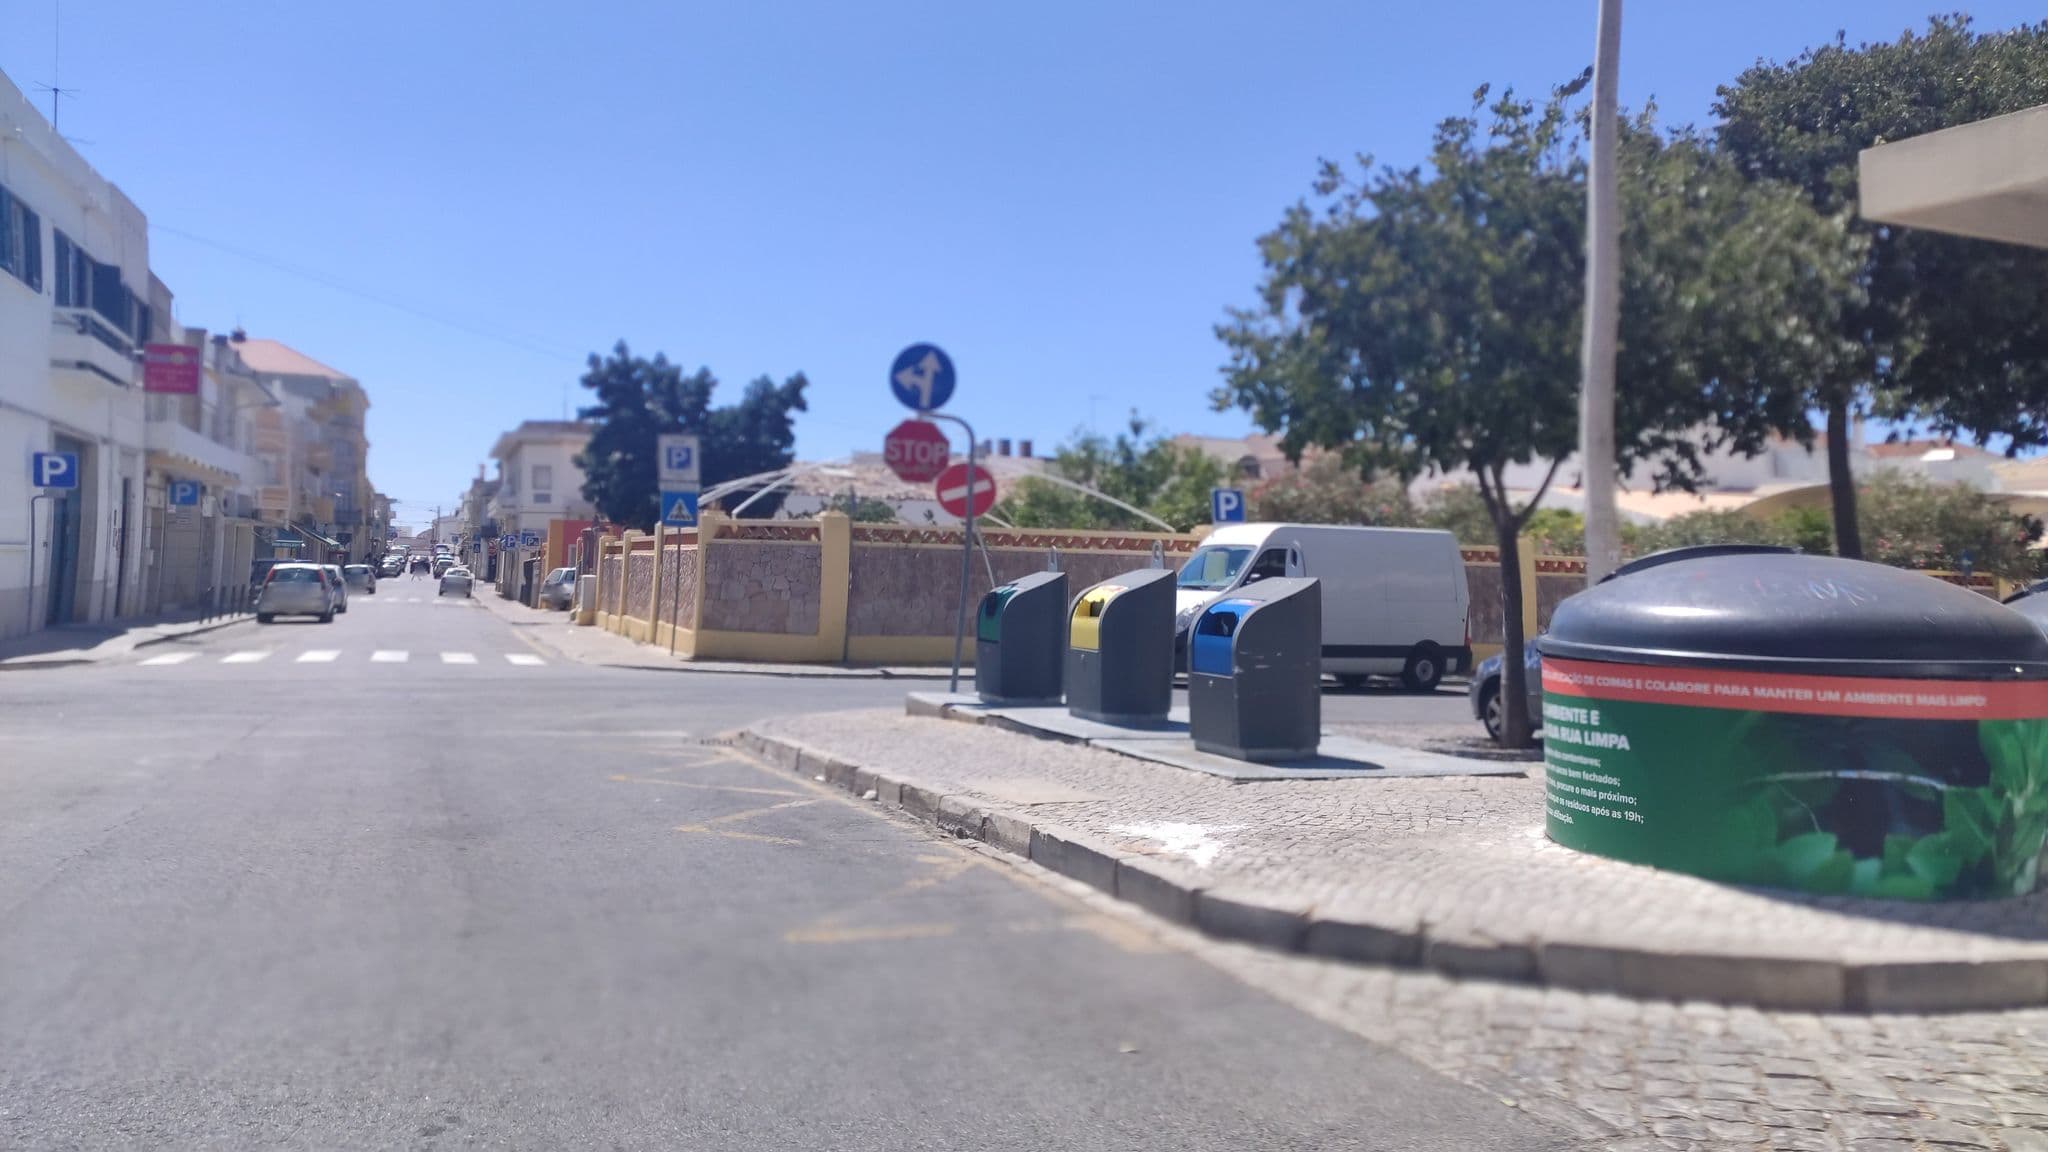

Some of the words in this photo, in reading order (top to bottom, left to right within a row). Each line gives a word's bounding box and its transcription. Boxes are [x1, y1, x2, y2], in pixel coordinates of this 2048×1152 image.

[884, 438, 946, 465] STOP
[41, 455, 68, 485] P
[175, 483, 193, 503] P
[1219, 492, 1239, 520] P
[1635, 679, 1643, 690] E
[1645, 679, 1713, 695] COLABORE
[1714, 683, 1750, 697] PARA
[1753, 686, 1813, 701] MANTER
[1817, 690, 1841, 703] UM
[1844, 691, 1913, 706] AMBIENTE
[1590, 709, 1601, 726] E
[1584, 731, 1631, 751] LIMPA
[1583, 770, 1621, 787] fechados;
[1581, 787, 1597, 798] mais
[1599, 791, 1637, 806] próximo;
[1566, 799, 1590, 813] resíduos
[1591, 806, 1610, 817] após
[1611, 809, 1622, 819] as
[1624, 811, 1645, 824] 19h;
